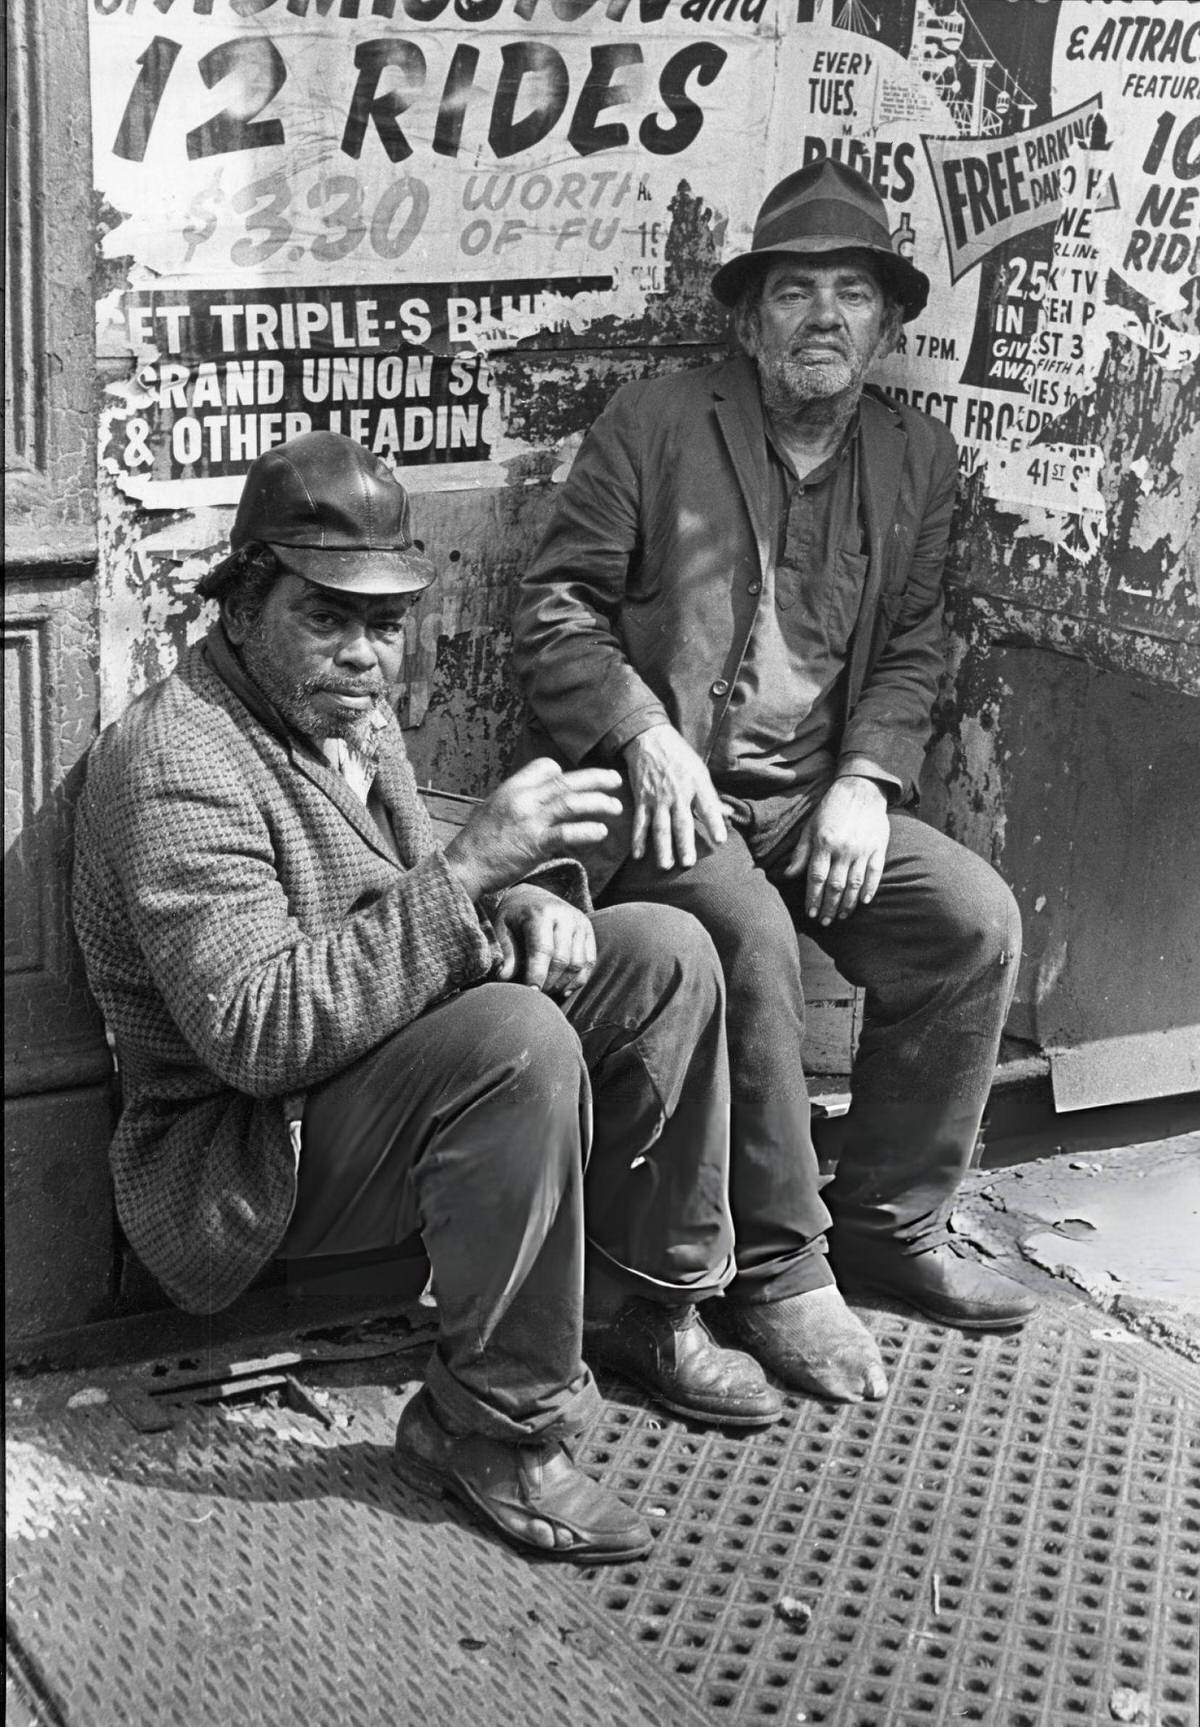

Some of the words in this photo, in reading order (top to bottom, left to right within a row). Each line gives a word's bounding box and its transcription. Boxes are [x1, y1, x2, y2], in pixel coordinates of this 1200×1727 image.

[1066, 25, 1089, 61] &
[112, 36, 288, 162] 12
[341, 37, 728, 163] RIDES
[808, 78, 857, 117] TUES.
[1122, 73, 1200, 100] FEATUR
[943, 145, 1031, 250] FREE
[460, 219, 527, 257] OF
[210, 298, 432, 352] TRIPLE-S
[996, 305, 1024, 335] IN
[916, 334, 927, 356] 7
[1070, 334, 1083, 359] 3
[303, 355, 434, 403] UNION
[1037, 358, 1073, 375] FIFTH
[123, 418, 155, 467] &
